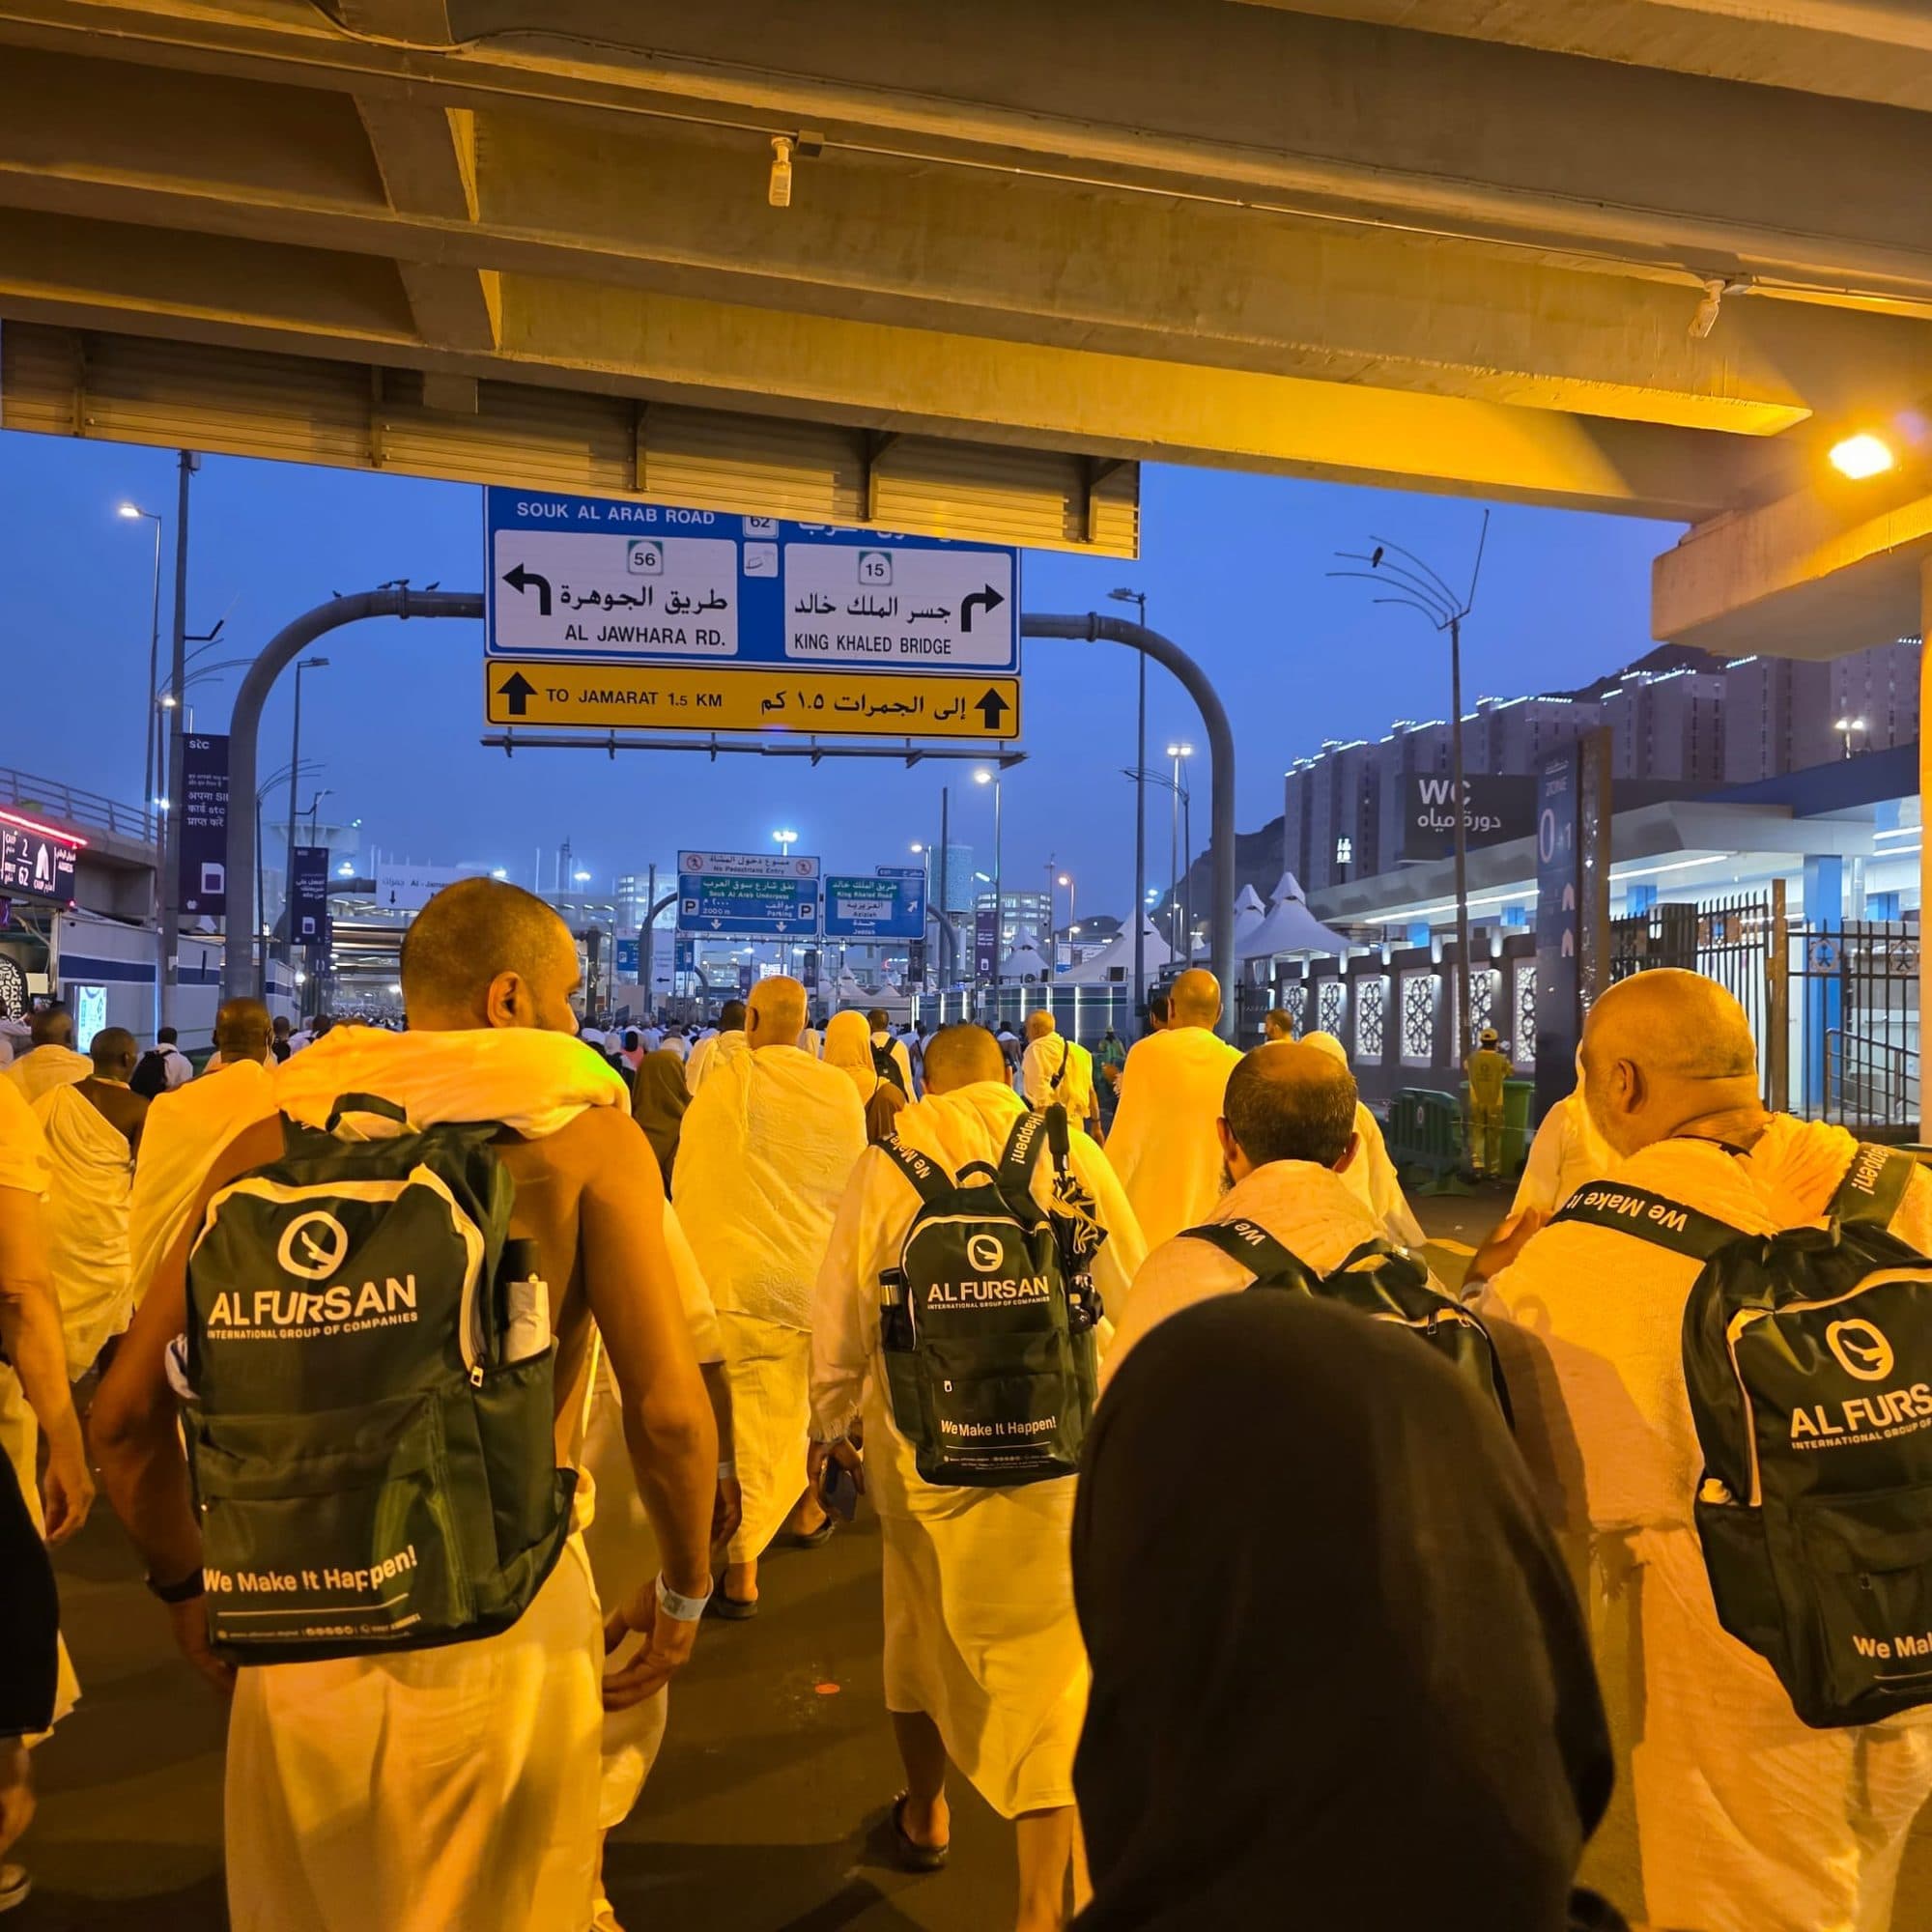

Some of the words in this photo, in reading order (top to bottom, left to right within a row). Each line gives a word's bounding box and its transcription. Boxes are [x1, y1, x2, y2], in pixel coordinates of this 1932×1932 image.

[517, 501, 568, 519] SOUK
[578, 504, 601, 520] AL
[608, 507, 657, 523] ARAB
[666, 509, 715, 526] ROAD
[634, 553, 656, 567] 56
[866, 563, 884, 578] 15
[560, 585, 654, 611] الجوهرة
[665, 588, 728, 615] طريق
[794, 593, 837, 615] خالد
[846, 595, 898, 617] الملك
[906, 605, 952, 624] جسر
[564, 624, 588, 641] AL
[597, 625, 687, 645] JAWHARA
[696, 629, 725, 646] RD.
[794, 634, 829, 650] KING
[837, 635, 893, 653] KHALED
[900, 638, 952, 655] BRIDGE
[546, 689, 569, 702] TO
[579, 690, 658, 705] JAMARAT
[668, 693, 688, 706] 1.5
[696, 694, 723, 707] KM
[761, 691, 786, 716] كم
[834, 694, 924, 717] الجمرات
[933, 696, 966, 721] إلى
[188, 739, 210, 750] stc
[1418, 779, 1471, 806] WC
[1417, 808, 1456, 833] مياه
[1463, 810, 1502, 833] دورة
[22, 838, 28, 858] 2
[18, 867, 29, 887] 62
[702, 879, 730, 889] العرب
[733, 881, 753, 891] سوق
[685, 900, 696, 914] P
[801, 904, 811, 918] P
[1851, 1147, 1889, 1195] appen!
[1567, 1193, 1583, 1209] It
[1583, 1191, 1646, 1219] Make
[1648, 1205, 1688, 1233] We
[1235, 1222, 1266, 1246] We
[254, 1273, 417, 1326] FURSAN
[927, 1282, 957, 1302] AL
[960, 1275, 1049, 1301] FURSAN
[1012, 1295, 1050, 1306] COMPANIES
[207, 1328, 278, 1341] INTERNATIONAL
[279, 1325, 321, 1340] GROUP
[324, 1322, 341, 1335] OF
[343, 1311, 418, 1334] COMPANIES
[1790, 1405, 1844, 1438] AL
[1841, 1382, 1932, 1432] FURS
[941, 1419, 958, 1435] We
[958, 1423, 993, 1437] Make
[995, 1422, 1005, 1435] It
[1008, 1415, 1057, 1436] Happen!
[1791, 1431, 1883, 1450] INTERNATIONAL
[1884, 1422, 1918, 1438] GROUP
[203, 1568, 233, 1593] We
[237, 1571, 298, 1593] Make
[301, 1570, 320, 1591] It
[1852, 1634, 1891, 1659] We
